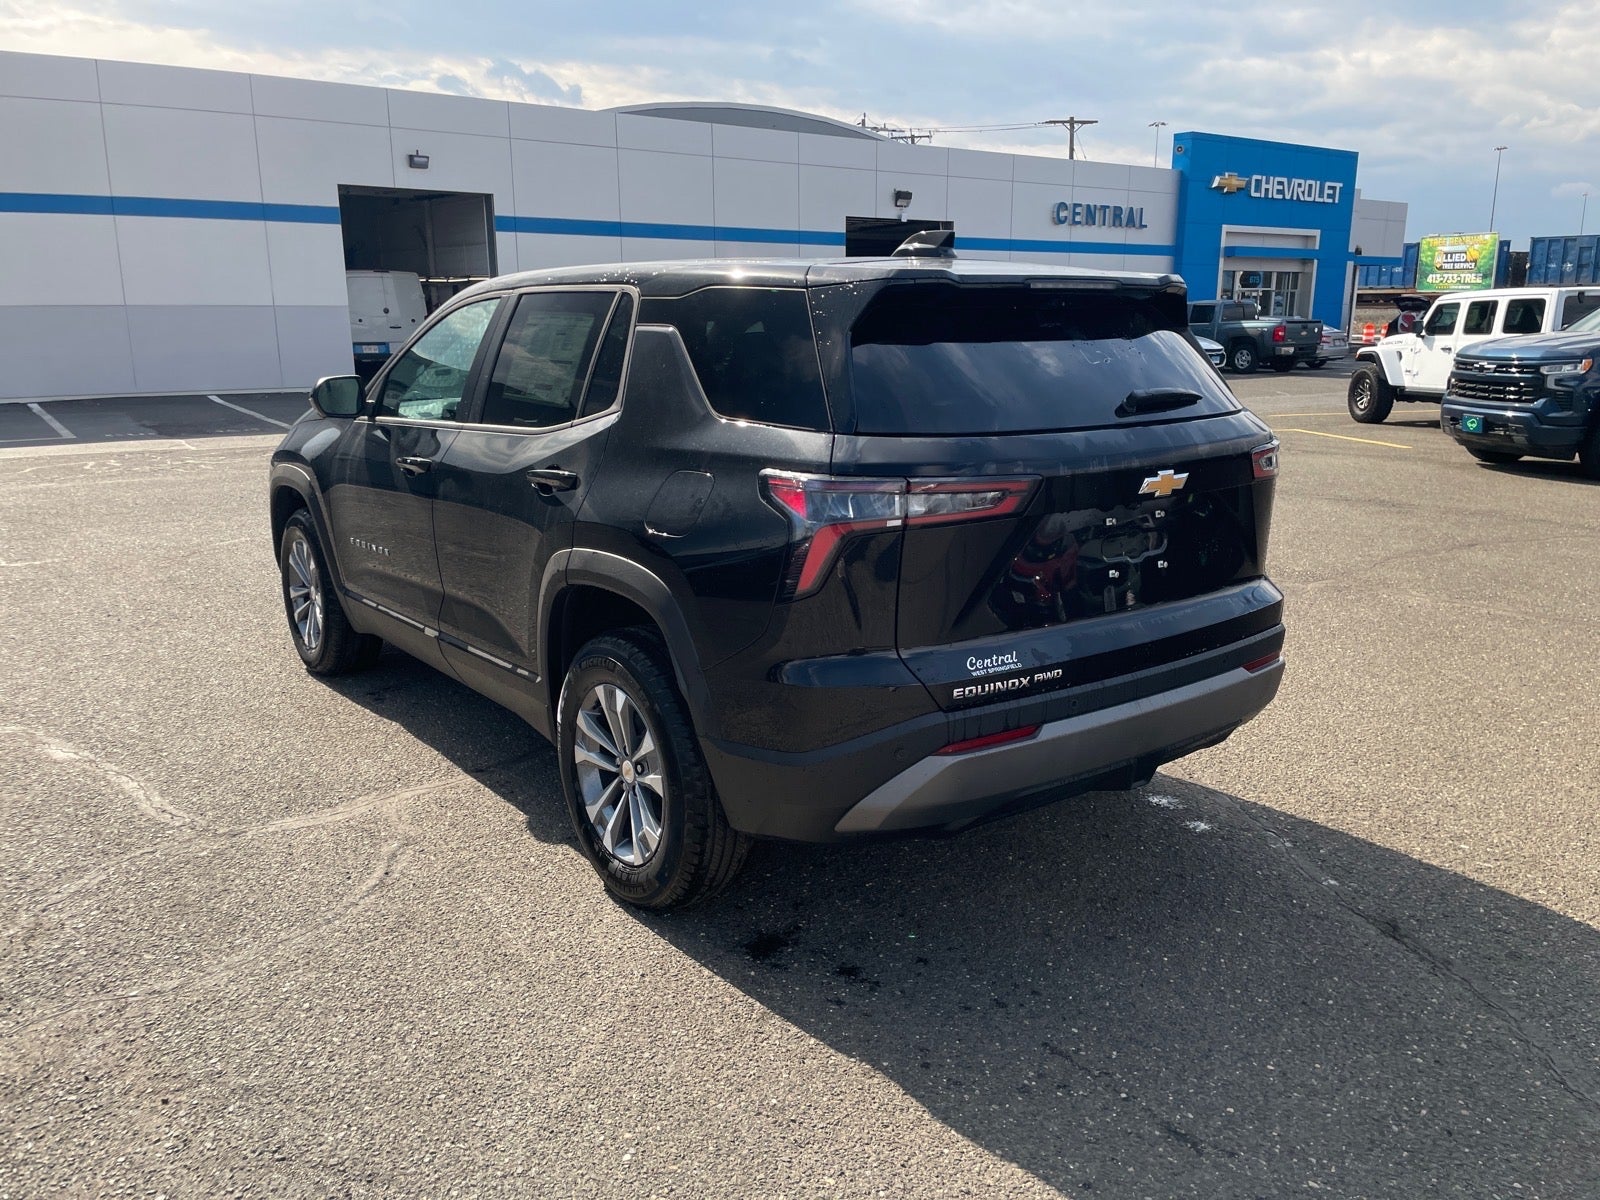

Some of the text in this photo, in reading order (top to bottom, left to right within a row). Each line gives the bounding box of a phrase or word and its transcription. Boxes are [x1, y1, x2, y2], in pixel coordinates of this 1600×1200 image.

[1250, 174, 1343, 204] CHEVROLET
[1054, 201, 1148, 228] CENTRAL
[1442, 262, 1476, 270] TREE SERVICE
[1427, 273, 1483, 284] 413-733-TREE
[350, 537, 389, 557] EQUINOX
[966, 650, 1018, 670] Central
[971, 662, 1022, 677] WEST SPRINGFIELD
[953, 669, 1062, 699] EQUINOX AWD
